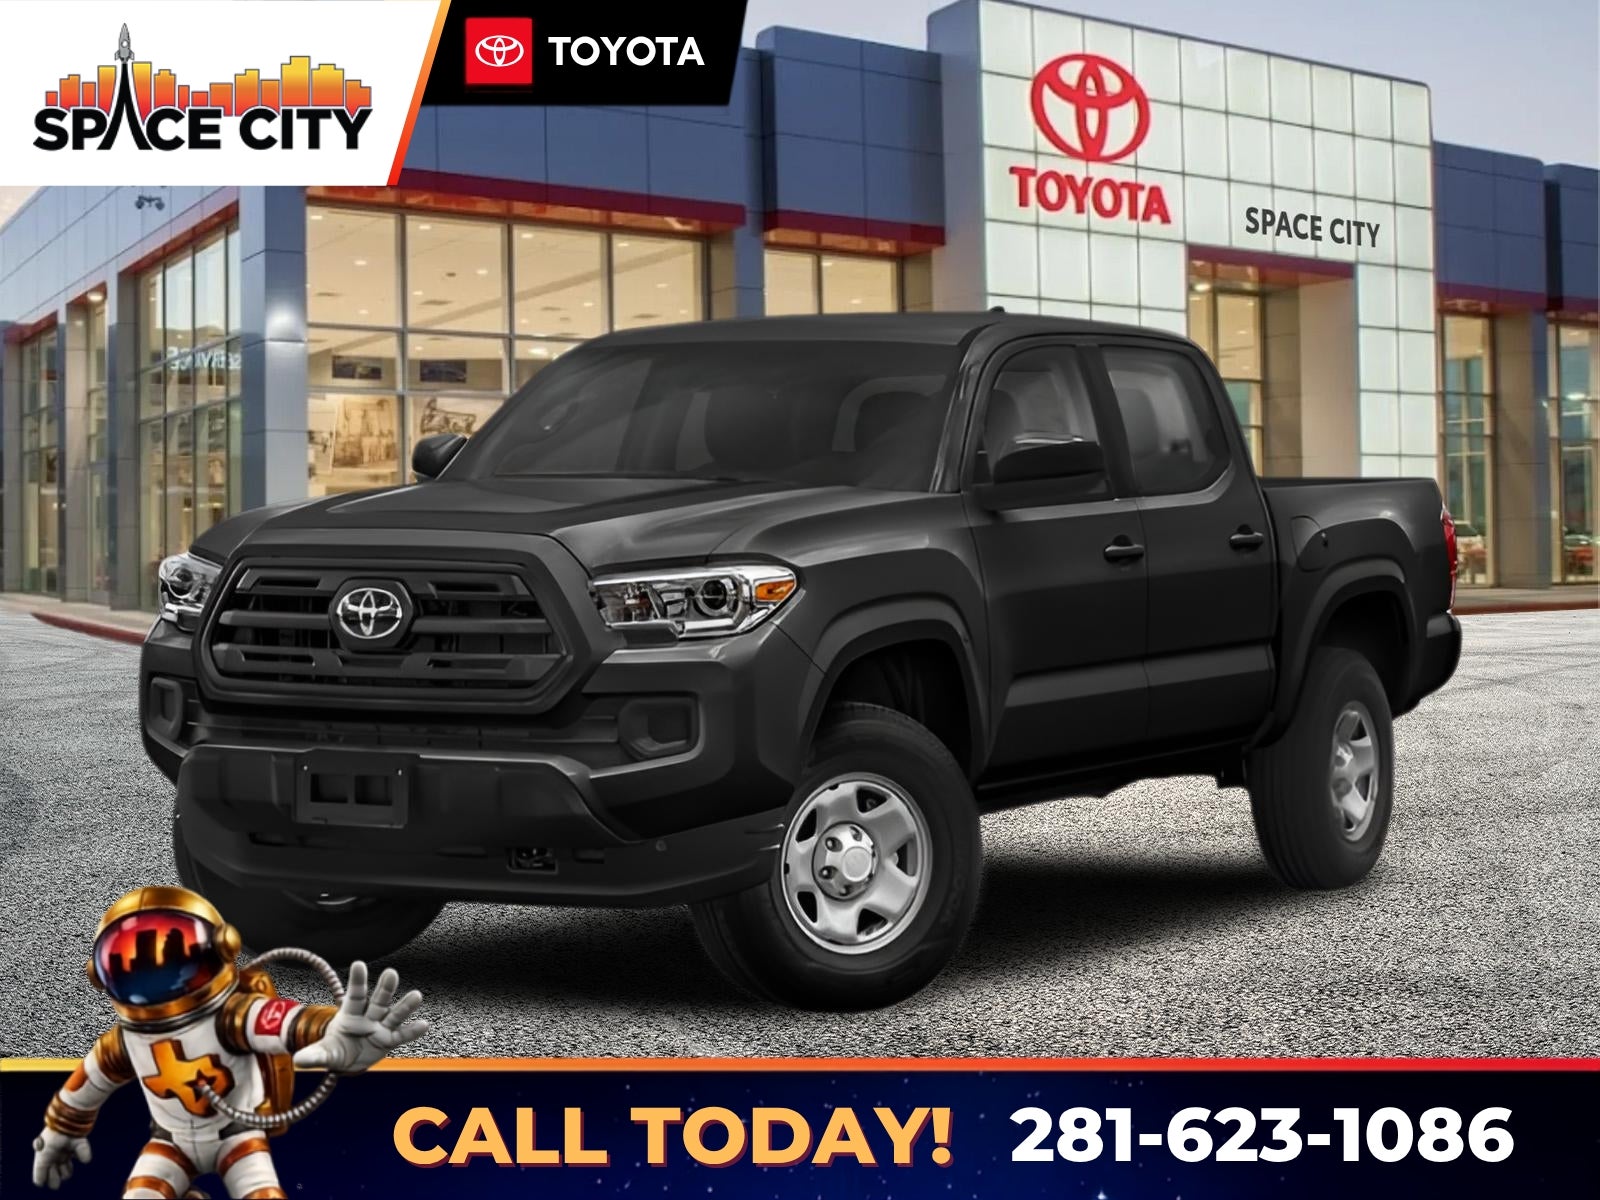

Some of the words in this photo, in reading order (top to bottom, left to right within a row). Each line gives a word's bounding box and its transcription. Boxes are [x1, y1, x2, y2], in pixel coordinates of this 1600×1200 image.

[1009, 165, 1171, 225] TOYOTA
[1245, 206, 1323, 242] SPACE
[1329, 218, 1381, 248] CITY
